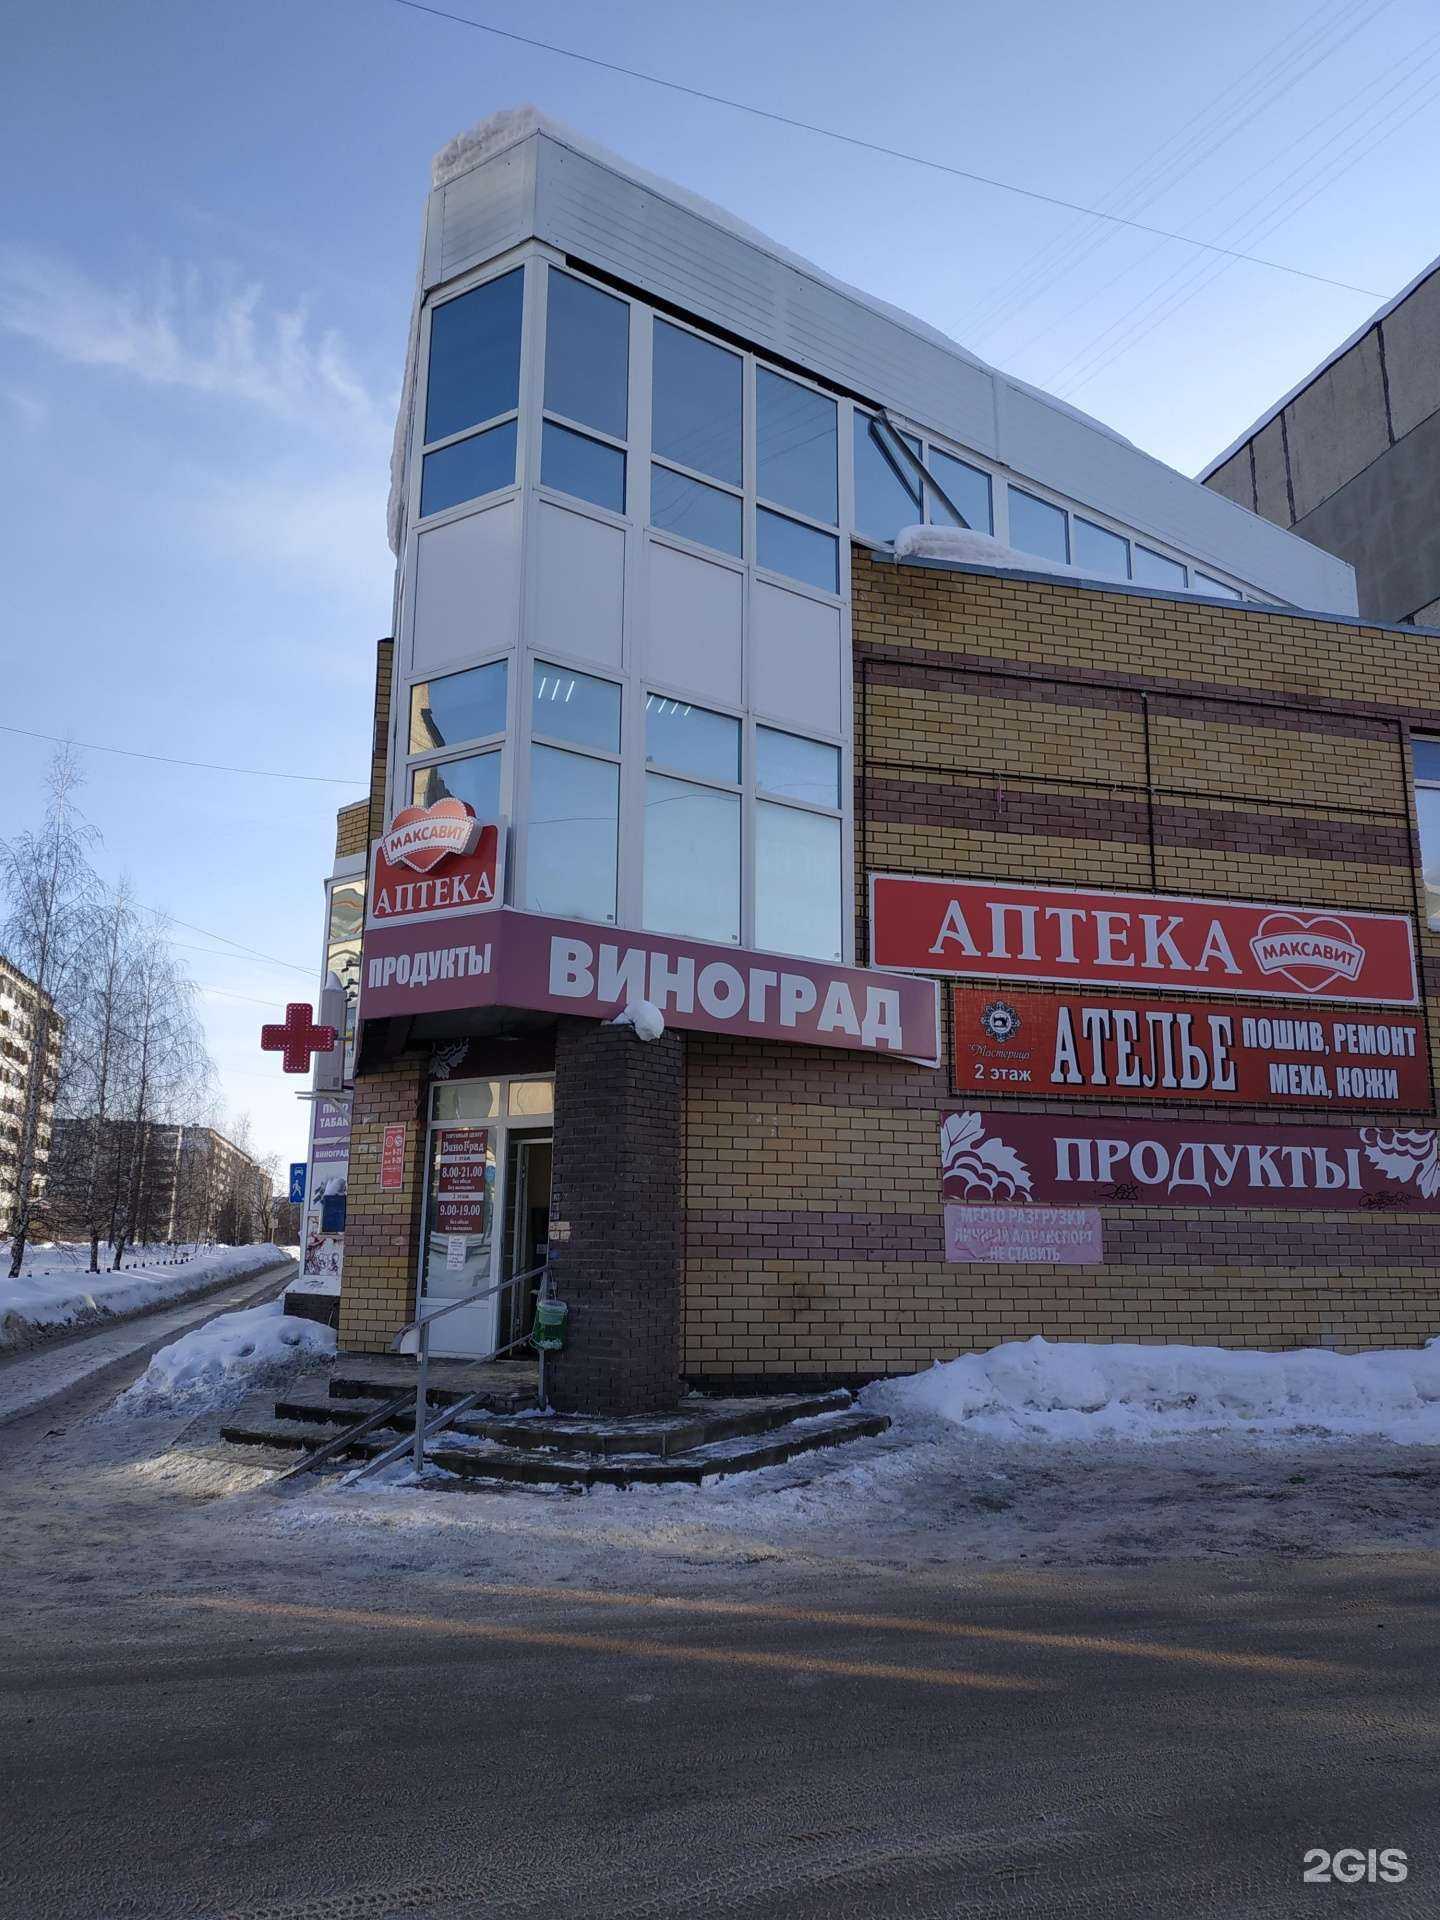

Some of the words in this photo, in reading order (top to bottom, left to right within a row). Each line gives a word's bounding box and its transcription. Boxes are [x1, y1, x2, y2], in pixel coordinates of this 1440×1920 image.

[390, 826, 463, 852] МАКСАВИТ
[374, 871, 494, 915] АПТЕКА
[928, 899, 1242, 975] АПТЕКА
[1262, 942, 1356, 967] МАКСАВИТ
[368, 943, 492, 989] ПРОДУКТЫ
[549, 936, 902, 1049] ВИНОГРАД
[1050, 1006, 1236, 1091] АТЕЛЬЕ
[1242, 1017, 1330, 1056] ПОШИВ,
[1333, 1023, 1417, 1057] РЕМОНТ
[974, 1063, 985, 1079] 2
[990, 1068, 1032, 1081] этаж
[1269, 1063, 1333, 1100] МЕХА,
[1336, 1066, 1399, 1100] КОЖИ
[1053, 1137, 1364, 1198] ПРОДУКТЫ
[960, 1207, 1007, 1224] МЕСТО
[1008, 1208, 1086, 1225] РАЗГРУЗКИ
[990, 1246, 1006, 1260] НЕ
[1007, 1246, 1061, 1261] СТАВИТЬ
